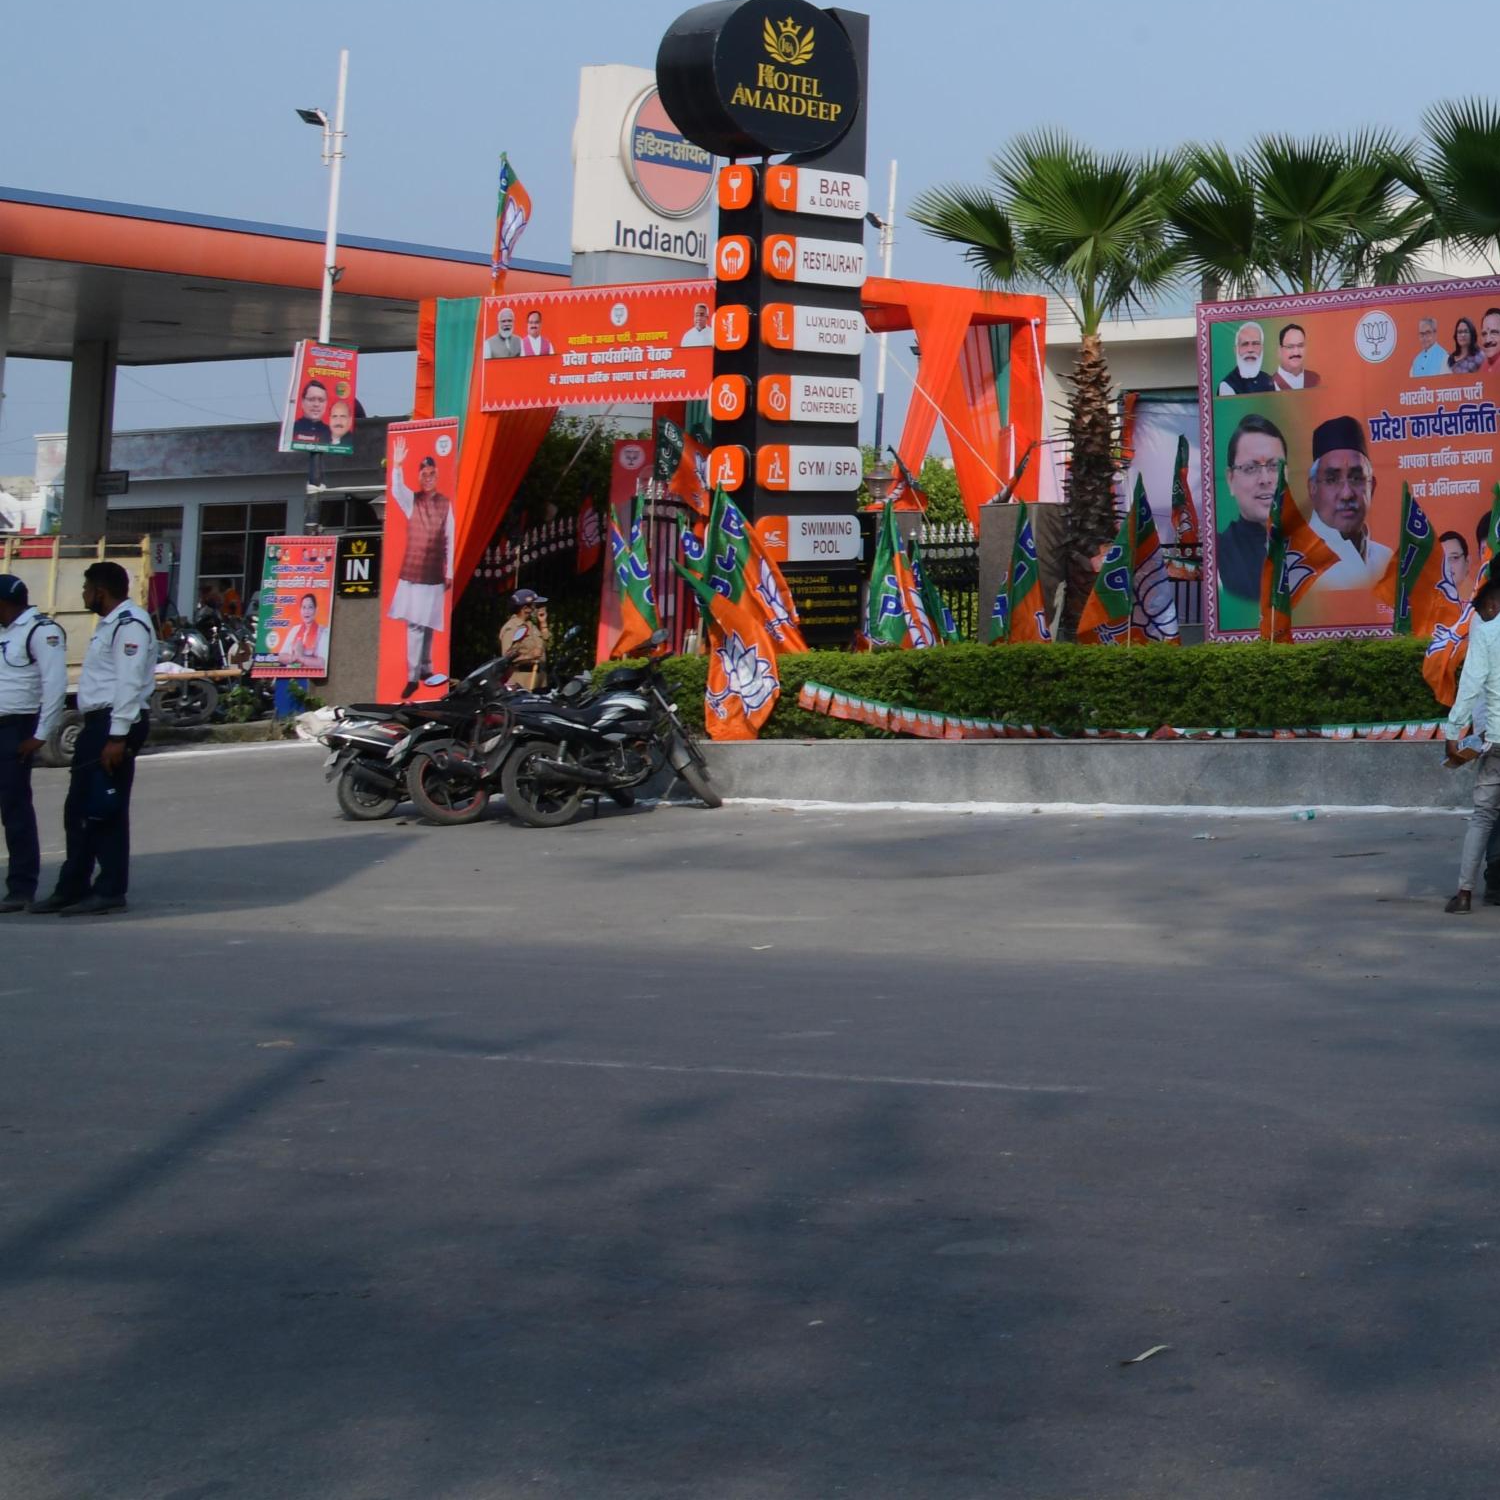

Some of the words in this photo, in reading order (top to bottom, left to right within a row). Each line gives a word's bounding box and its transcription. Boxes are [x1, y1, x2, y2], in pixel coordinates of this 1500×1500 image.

[758, 63, 822, 98] HOTEL
[731, 82, 841, 122] AMARDEEP
[820, 178, 850, 197] BAR
[809, 195, 816, 206] &
[819, 197, 861, 211] LOUNGE
[615, 220, 707, 260] IndianOil
[803, 251, 863, 275] RESTAURANT
[805, 316, 858, 332] LUXURIOUS
[818, 331, 847, 345] ROOM
[803, 384, 854, 400] BANQUET
[1400, 386, 1434, 405] भारतीय
[1436, 387, 1462, 403] जनता
[1463, 381, 1483, 400] पार्टी
[801, 402, 858, 416] CONFERENCE
[1368, 410, 1407, 443] प्रदेश
[1410, 402, 1497, 439] कार्यसमिति
[1398, 453, 1429, 469] आपका
[1430, 446, 1460, 467] हार्दिक
[1461, 449, 1493, 464] स्वागत
[798, 460, 825, 477] GYM
[835, 460, 858, 477] SPA
[1412, 479, 1427, 498] एवं
[1428, 478, 1480, 497] अभिनन्दन
[801, 521, 852, 536] SWIMMING
[812, 539, 840, 554] POOL
[346, 559, 369, 580] IN
